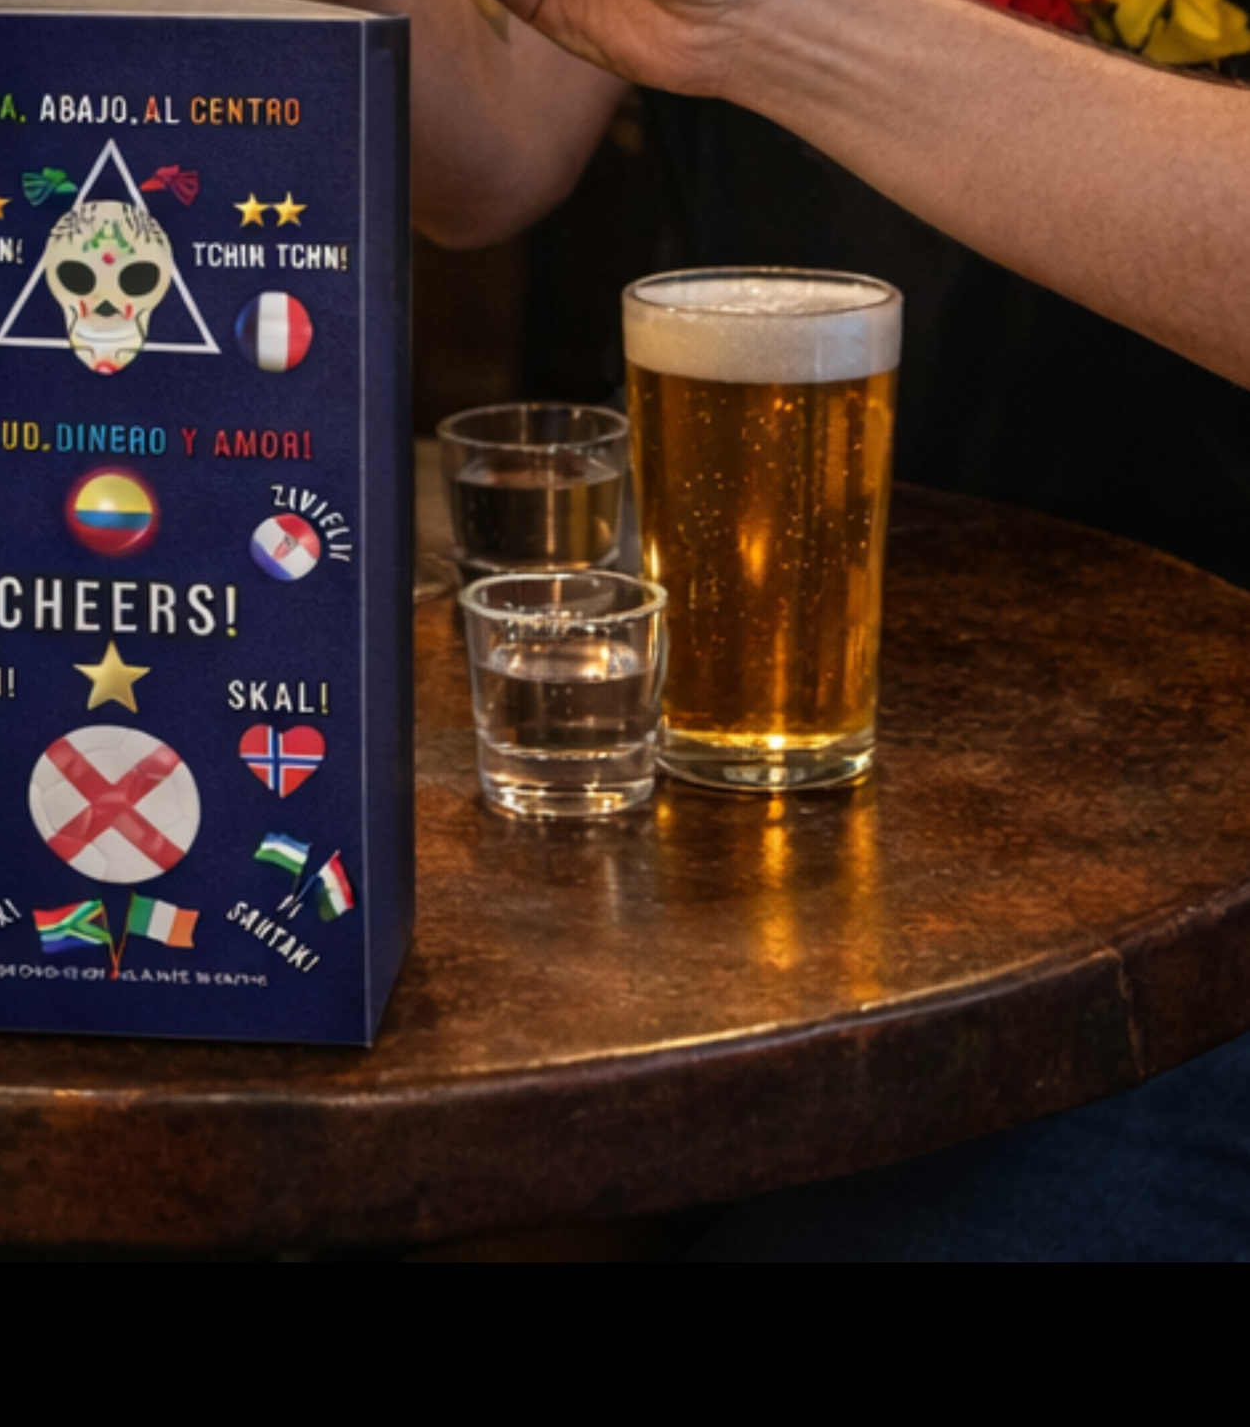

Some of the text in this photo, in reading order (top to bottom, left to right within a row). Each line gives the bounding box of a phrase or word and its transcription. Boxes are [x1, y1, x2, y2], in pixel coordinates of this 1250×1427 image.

[143, 95, 180, 124] AL
[190, 96, 300, 126] CENTRO
[192, 241, 265, 269] TCHIN
[56, 421, 166, 455] DINERO
[180, 426, 198, 456] Y
[213, 428, 313, 460] AMOR!
[228, 679, 328, 715] SKAL!
